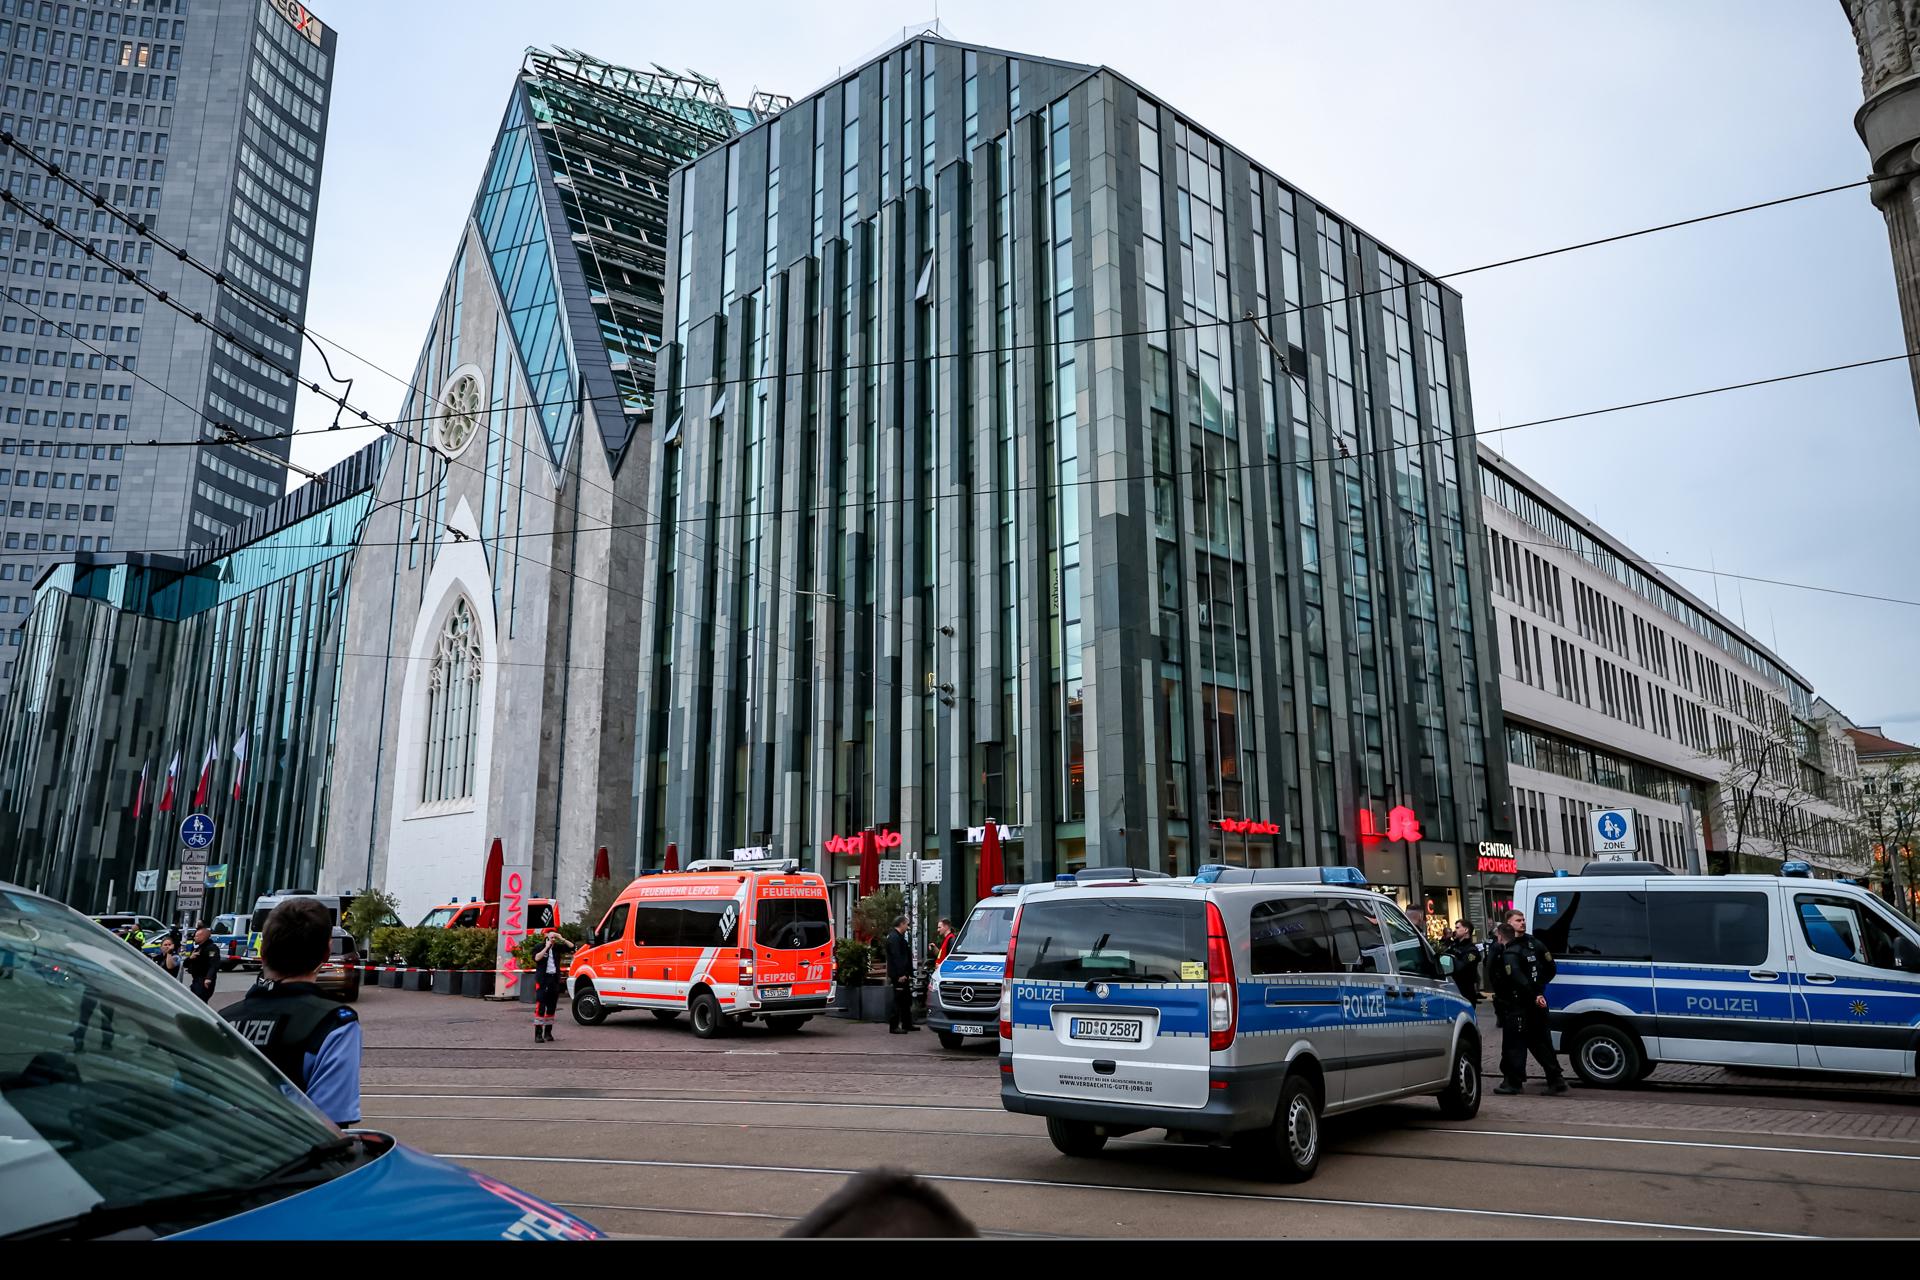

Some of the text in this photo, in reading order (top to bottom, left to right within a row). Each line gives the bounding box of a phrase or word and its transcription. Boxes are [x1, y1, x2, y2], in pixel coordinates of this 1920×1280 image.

[825, 828, 903, 855] VAPINO
[1478, 841, 1514, 858] CENTRAL
[1603, 841, 1626, 850] ZONE
[1478, 857, 1518, 873] APOTHEKE
[640, 885, 720, 897] FEUERWEHR LEIPZIG
[762, 887, 823, 897] FEUERWEHR
[719, 904, 735, 935] 112
[501, 872, 523, 989] VAPIANO
[806, 964, 824, 981] 112
[953, 964, 1004, 972] POLIZEI
[757, 972, 796, 983] LEIPZIG
[1017, 986, 1065, 1001] POLIZEI
[1343, 994, 1387, 1019] POLIZEI
[1686, 996, 1758, 1013] POLIZEI
[228, 1020, 276, 1046] IZEI
[1078, 1021, 1139, 1037] DD Q 2587
[1059, 1079, 1153, 1092] WWW.VERDAECHTIG-GUTE-JOBS.DE
